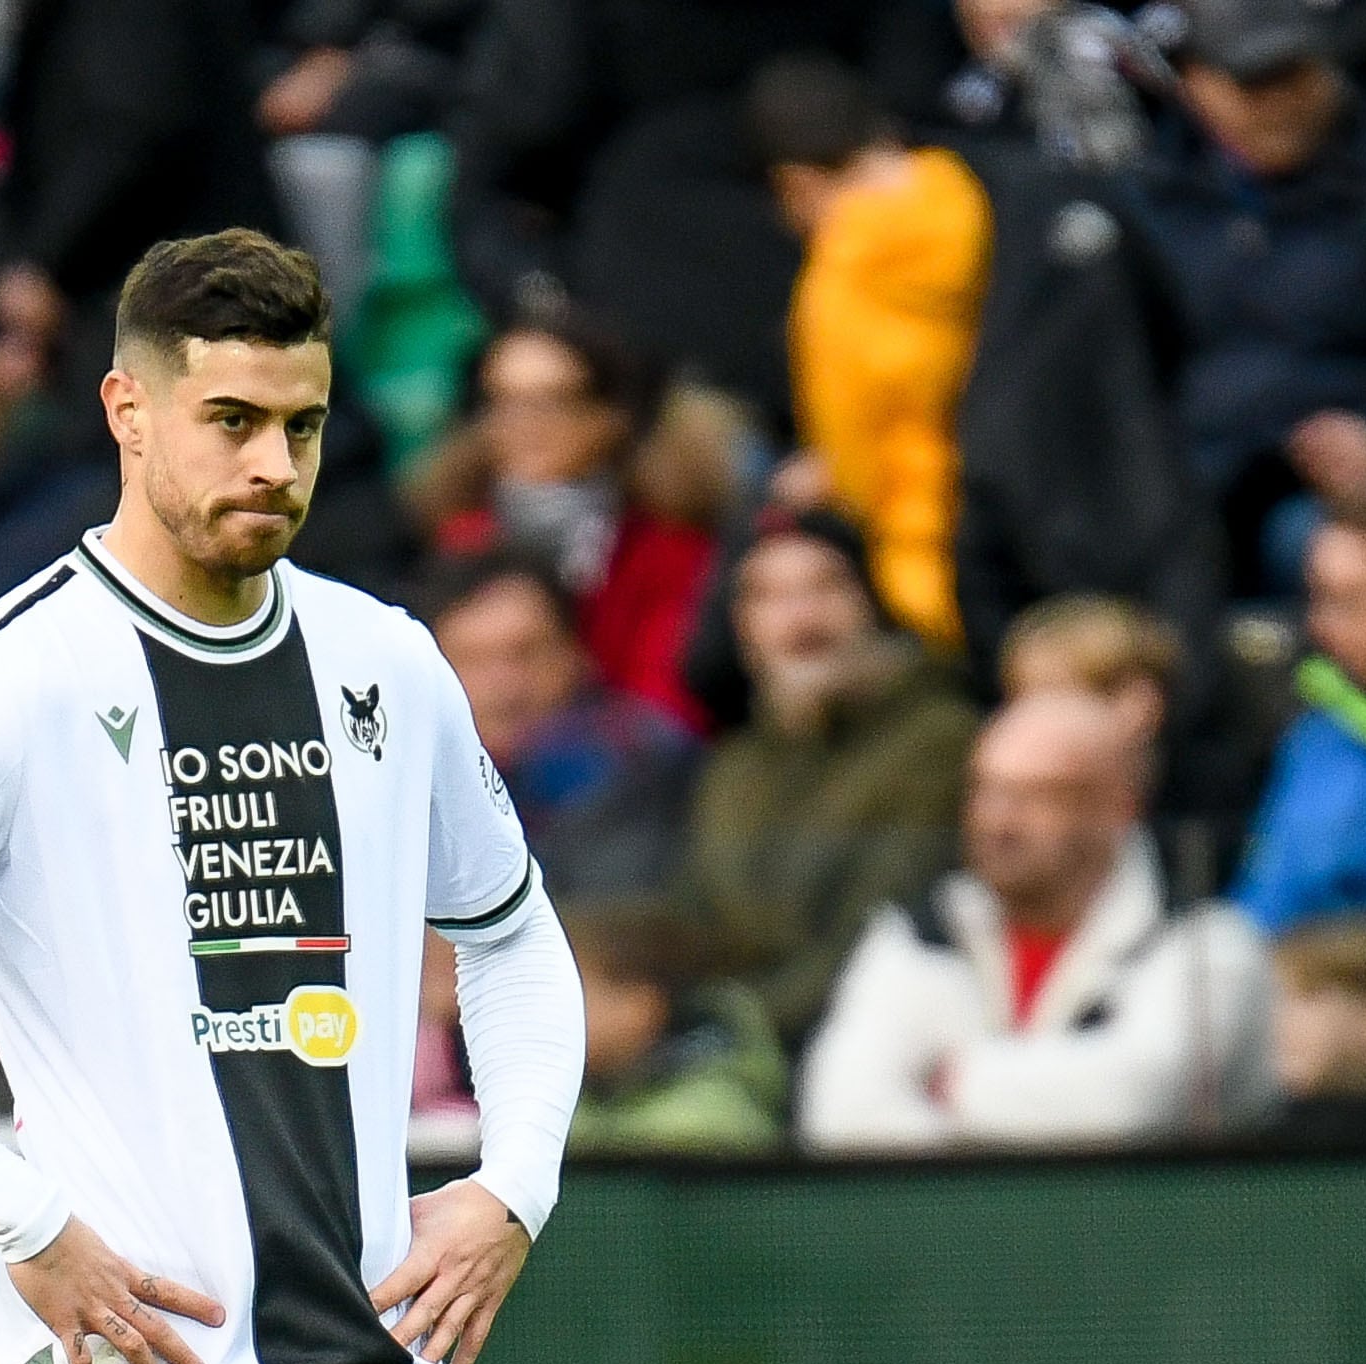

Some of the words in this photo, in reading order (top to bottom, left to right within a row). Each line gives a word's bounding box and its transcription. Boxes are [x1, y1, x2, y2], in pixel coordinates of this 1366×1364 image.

[161, 748, 208, 785] IO
[220, 740, 332, 781] SONO
[170, 792, 277, 832] FRIULI
[172, 837, 336, 881] VENEZIA
[185, 888, 306, 929] GIULIA
